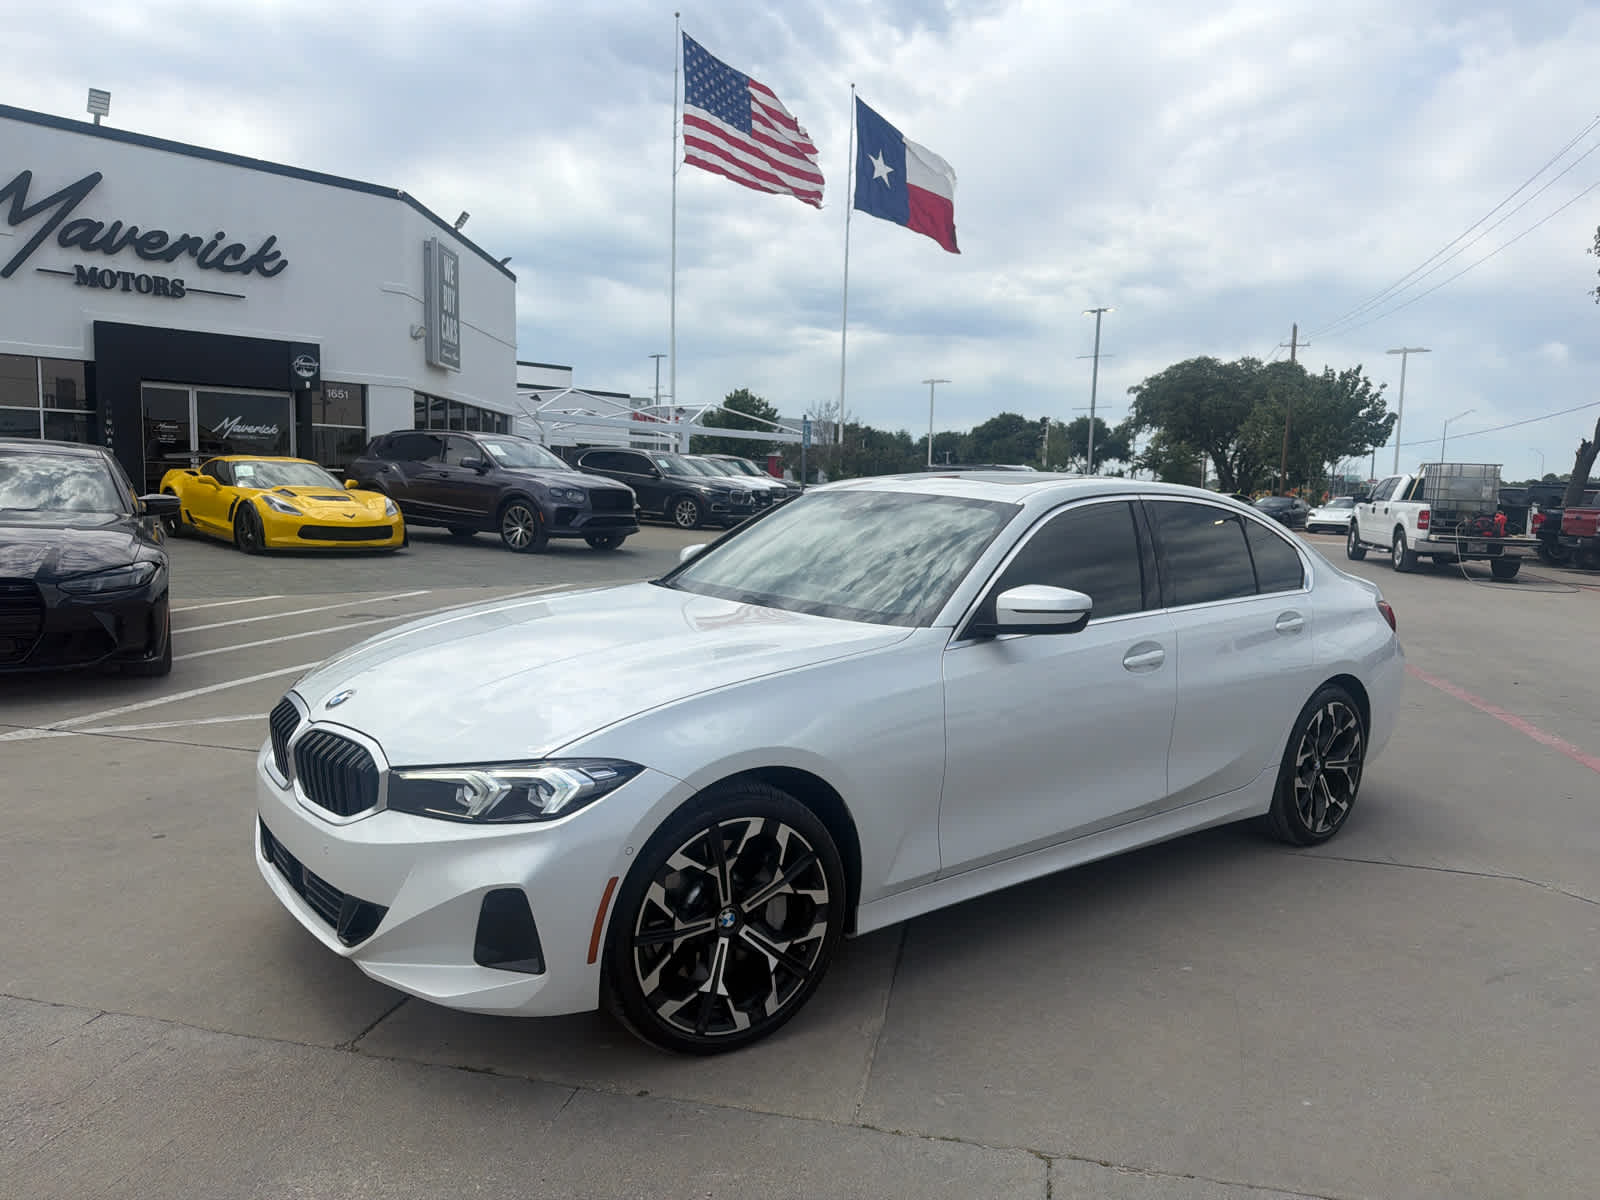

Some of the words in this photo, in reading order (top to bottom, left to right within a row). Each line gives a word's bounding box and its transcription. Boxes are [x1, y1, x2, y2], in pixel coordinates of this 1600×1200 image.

[0, 170, 289, 278] Maverick
[74, 265, 187, 299] MOTORS
[443, 254, 455, 285] WE
[443, 284, 456, 314] BUY
[441, 313, 458, 345] CARS
[327, 389, 349, 400] 1651
[211, 415, 279, 439] Maverick
